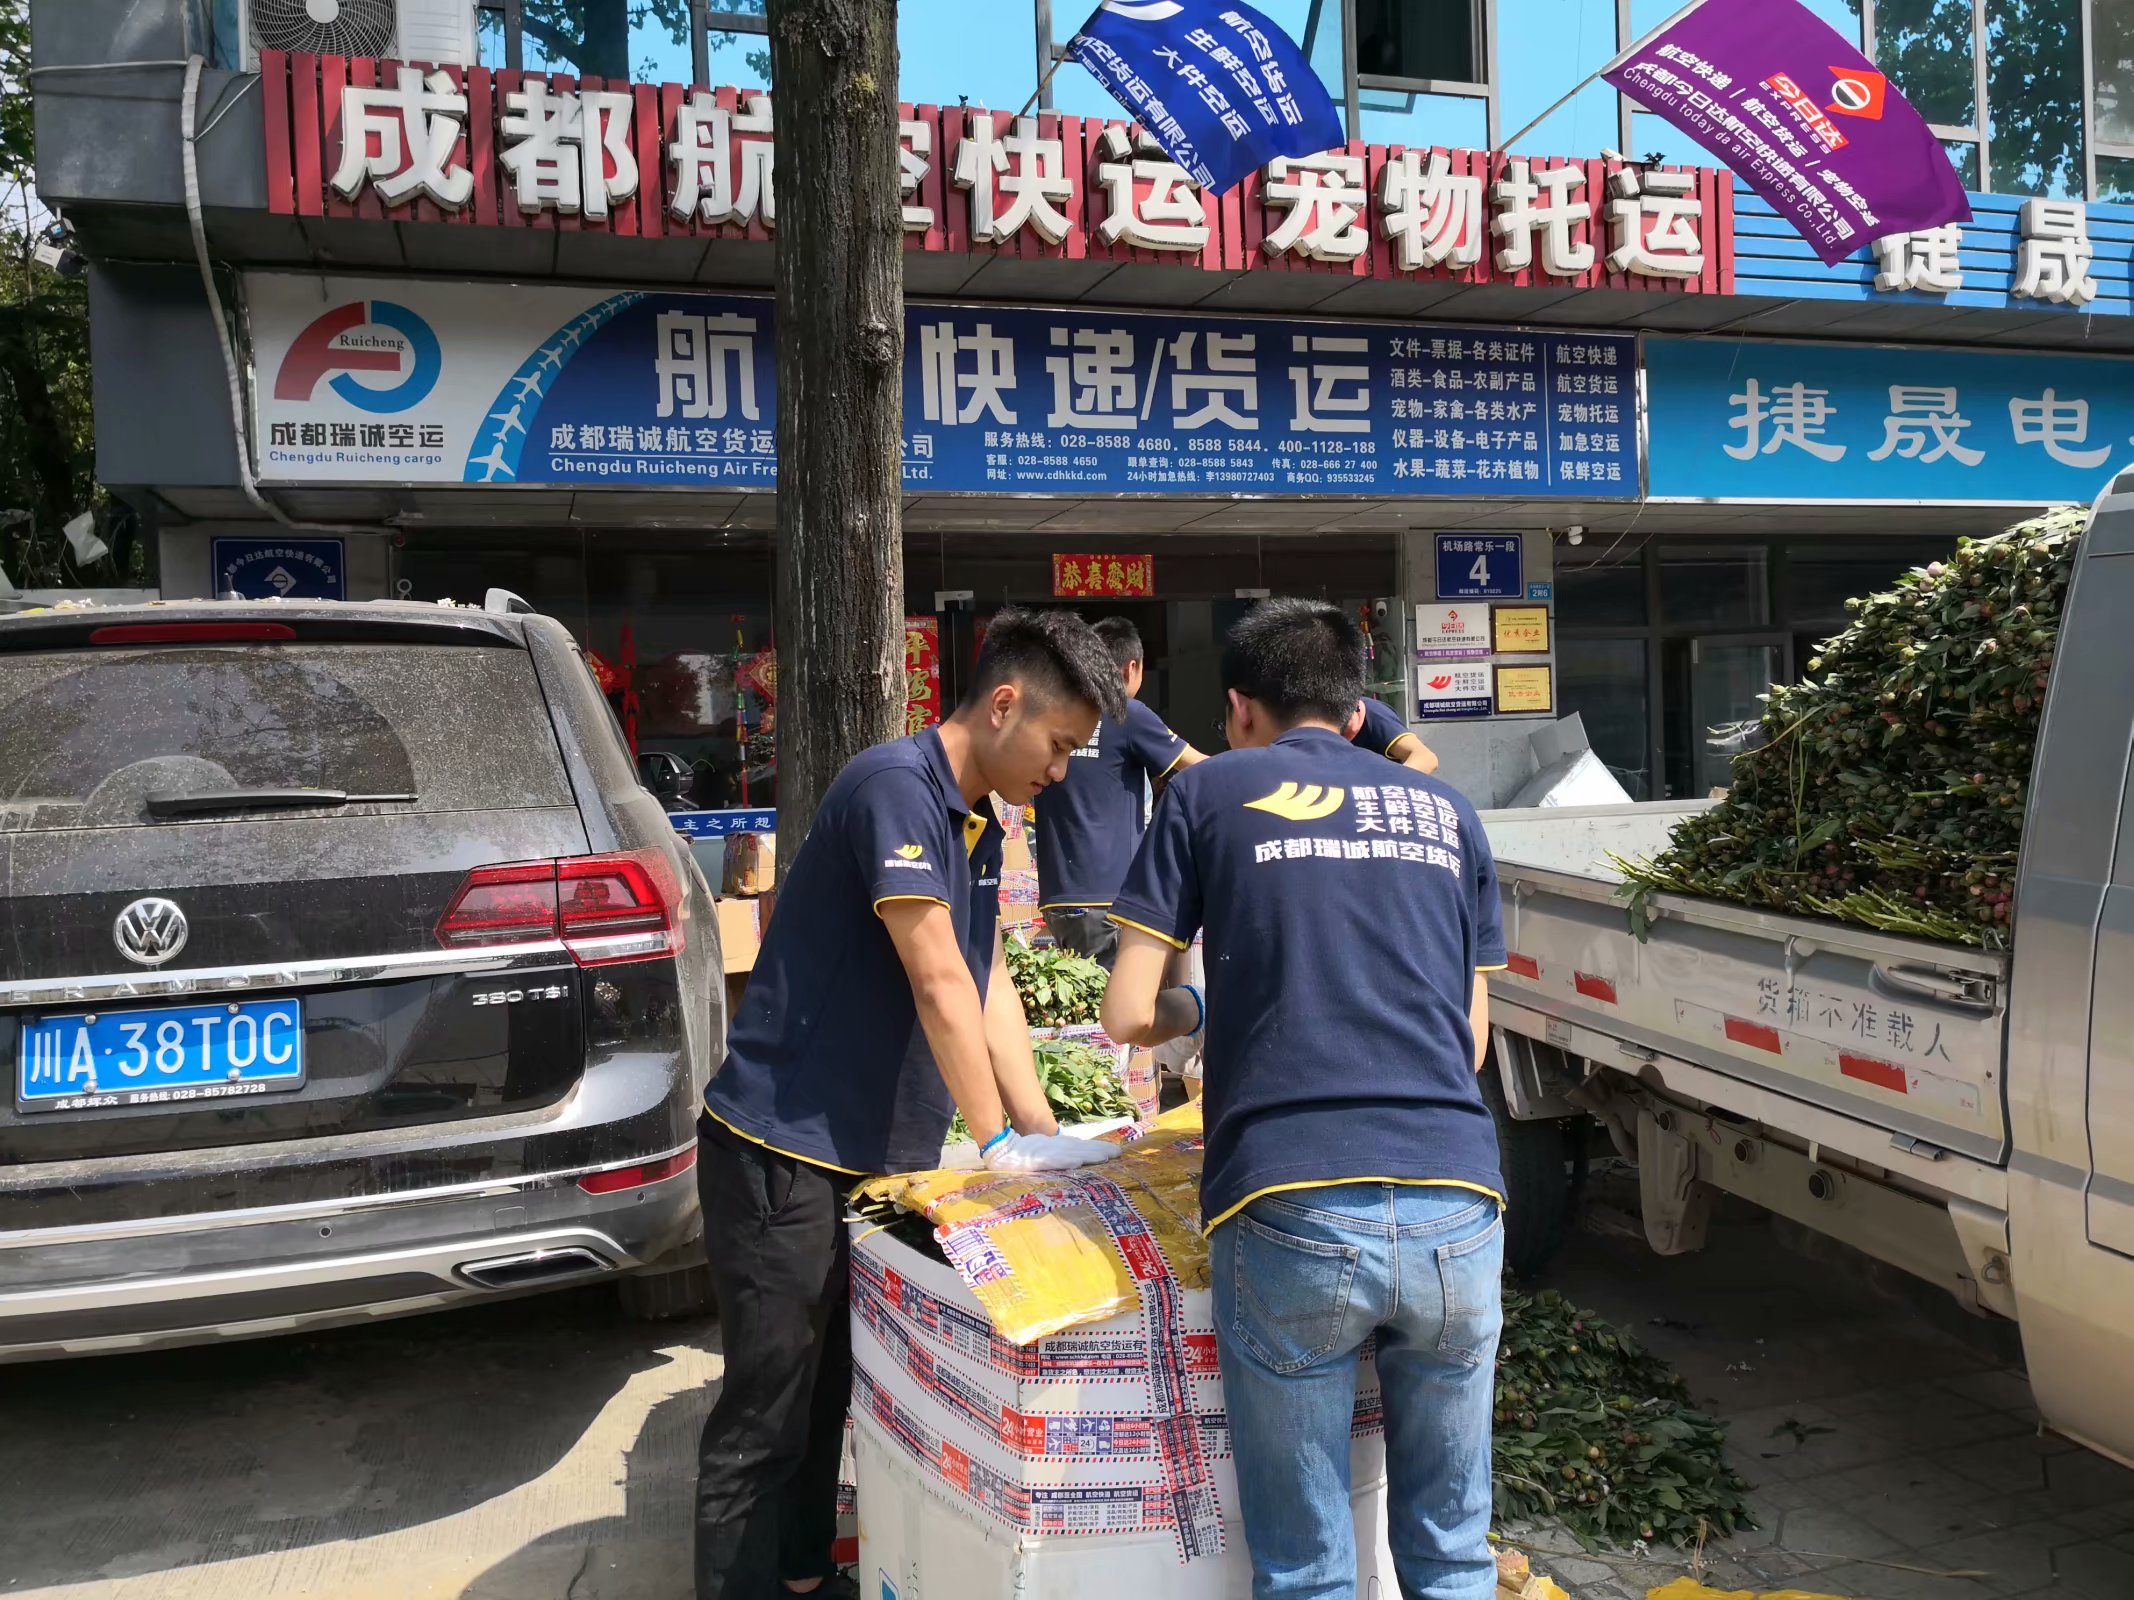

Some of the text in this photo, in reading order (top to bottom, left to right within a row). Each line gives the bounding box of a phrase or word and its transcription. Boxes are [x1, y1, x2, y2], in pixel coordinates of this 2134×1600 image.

[1184, 28, 1280, 126] 生鲜空运
[1218, 10, 1303, 127] 航空货运
[1152, 44, 1252, 142] 大件空运
[1758, 80, 1831, 155] EXPRESS
[1623, 67, 1685, 106] Chengdu
[1678, 97, 1715, 136] today
[1714, 131, 1731, 151] da
[1731, 141, 1751, 160] air
[1749, 156, 1797, 205] Express
[339, 334, 405, 351] Ruicheng
[1556, 345, 1618, 366] 航空快递
[1390, 367, 1537, 392] 酒类-食品-农副产品
[1557, 374, 1619, 395] 航空货运
[1391, 398, 1537, 421] 宠物-家禽-各类水产
[1558, 402, 1620, 424] 宠物托运
[270, 421, 444, 448] 成都瑞诚空运
[1188, 438, 1222, 452] 8588
[1392, 428, 1539, 451] 仪器-设备-电子产品
[1559, 432, 1621, 453] 加急空运
[269, 451, 442, 466] Chengdu Ruicheng cargo
[551, 457, 632, 475] Chengdu
[636, 459, 719, 477] Ruicheng
[723, 462, 749, 475] Air
[1393, 457, 1540, 481] 水果-蔬菜-花卉植物
[1560, 460, 1622, 482] 保鲜空运
[1442, 540, 1515, 552] 机场路常乐一段
[1469, 554, 1490, 586] 4
[173, 1083, 266, 1100] 028-85782728
